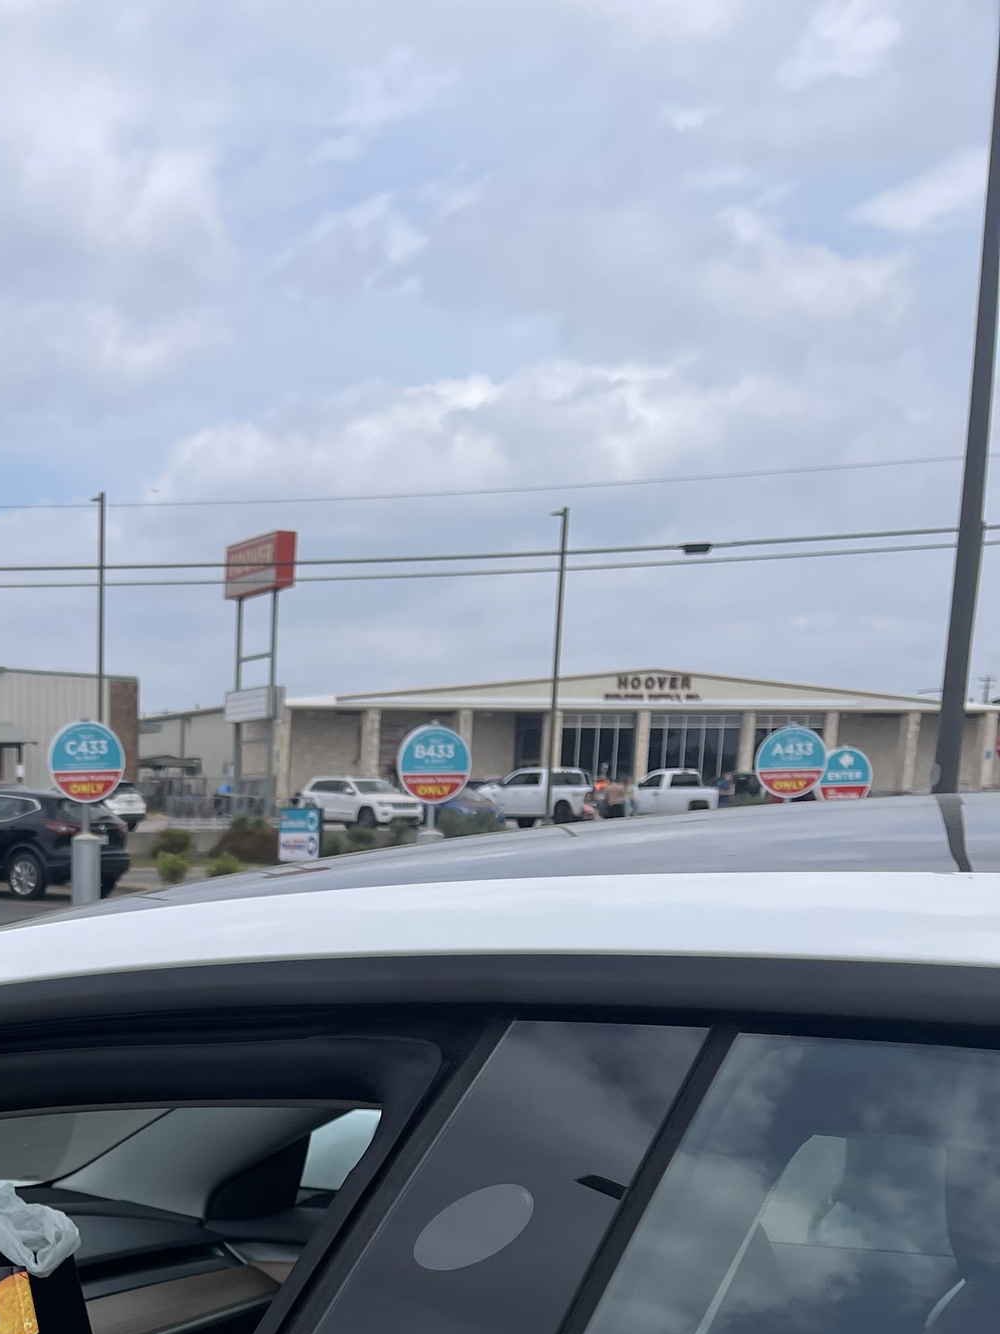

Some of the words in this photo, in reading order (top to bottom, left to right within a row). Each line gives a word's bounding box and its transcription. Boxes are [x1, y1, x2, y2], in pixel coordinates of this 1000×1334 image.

[617, 676, 692, 690] HOOVER
[65, 741, 108, 756] C433
[414, 744, 455, 759] B433
[772, 743, 814, 756] A433
[827, 771, 862, 780] ENTER
[69, 782, 105, 794] ONLY
[417, 784, 450, 796] ONLY
[773, 781, 806, 790] ONLY
